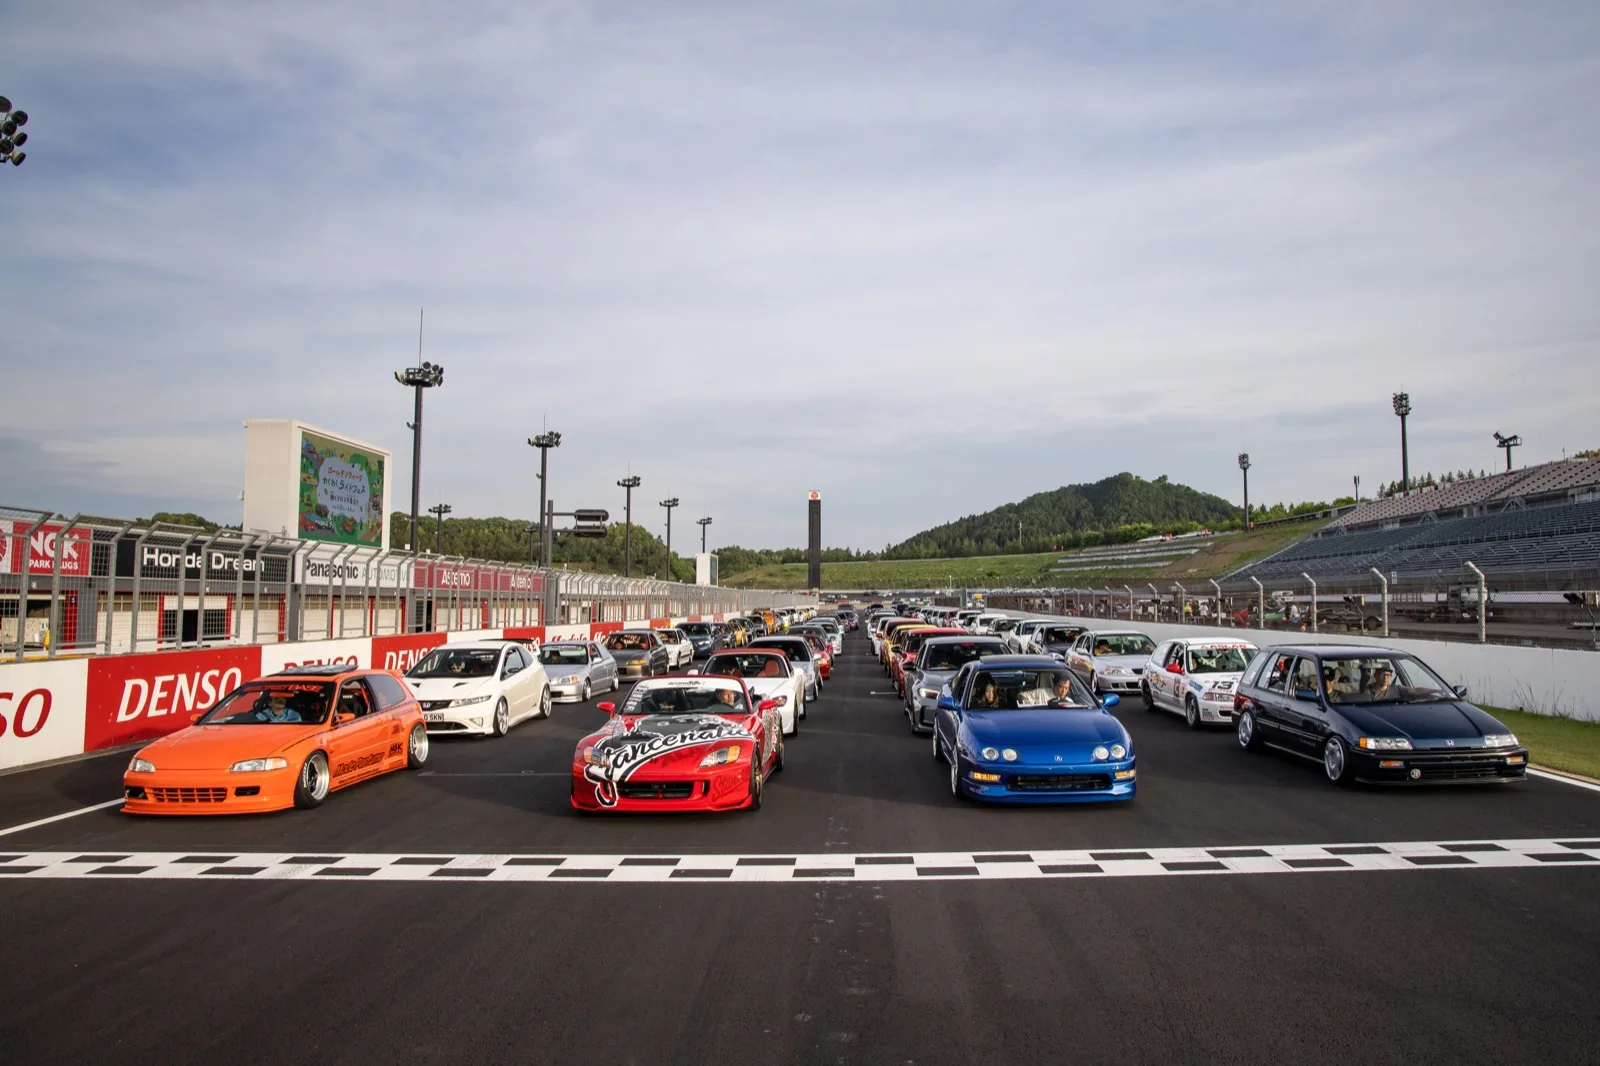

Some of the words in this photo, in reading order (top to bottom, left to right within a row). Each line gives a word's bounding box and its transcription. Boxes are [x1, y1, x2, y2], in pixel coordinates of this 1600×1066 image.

[30, 531, 79, 560] NGK
[28, 559, 50, 569] PARK
[305, 559, 359, 579] Panasonic
[441, 569, 471, 587] Astemo
[511, 574, 532, 589] Atemo
[1211, 681, 1234, 690] 13
[116, 667, 242, 723] DENSO
